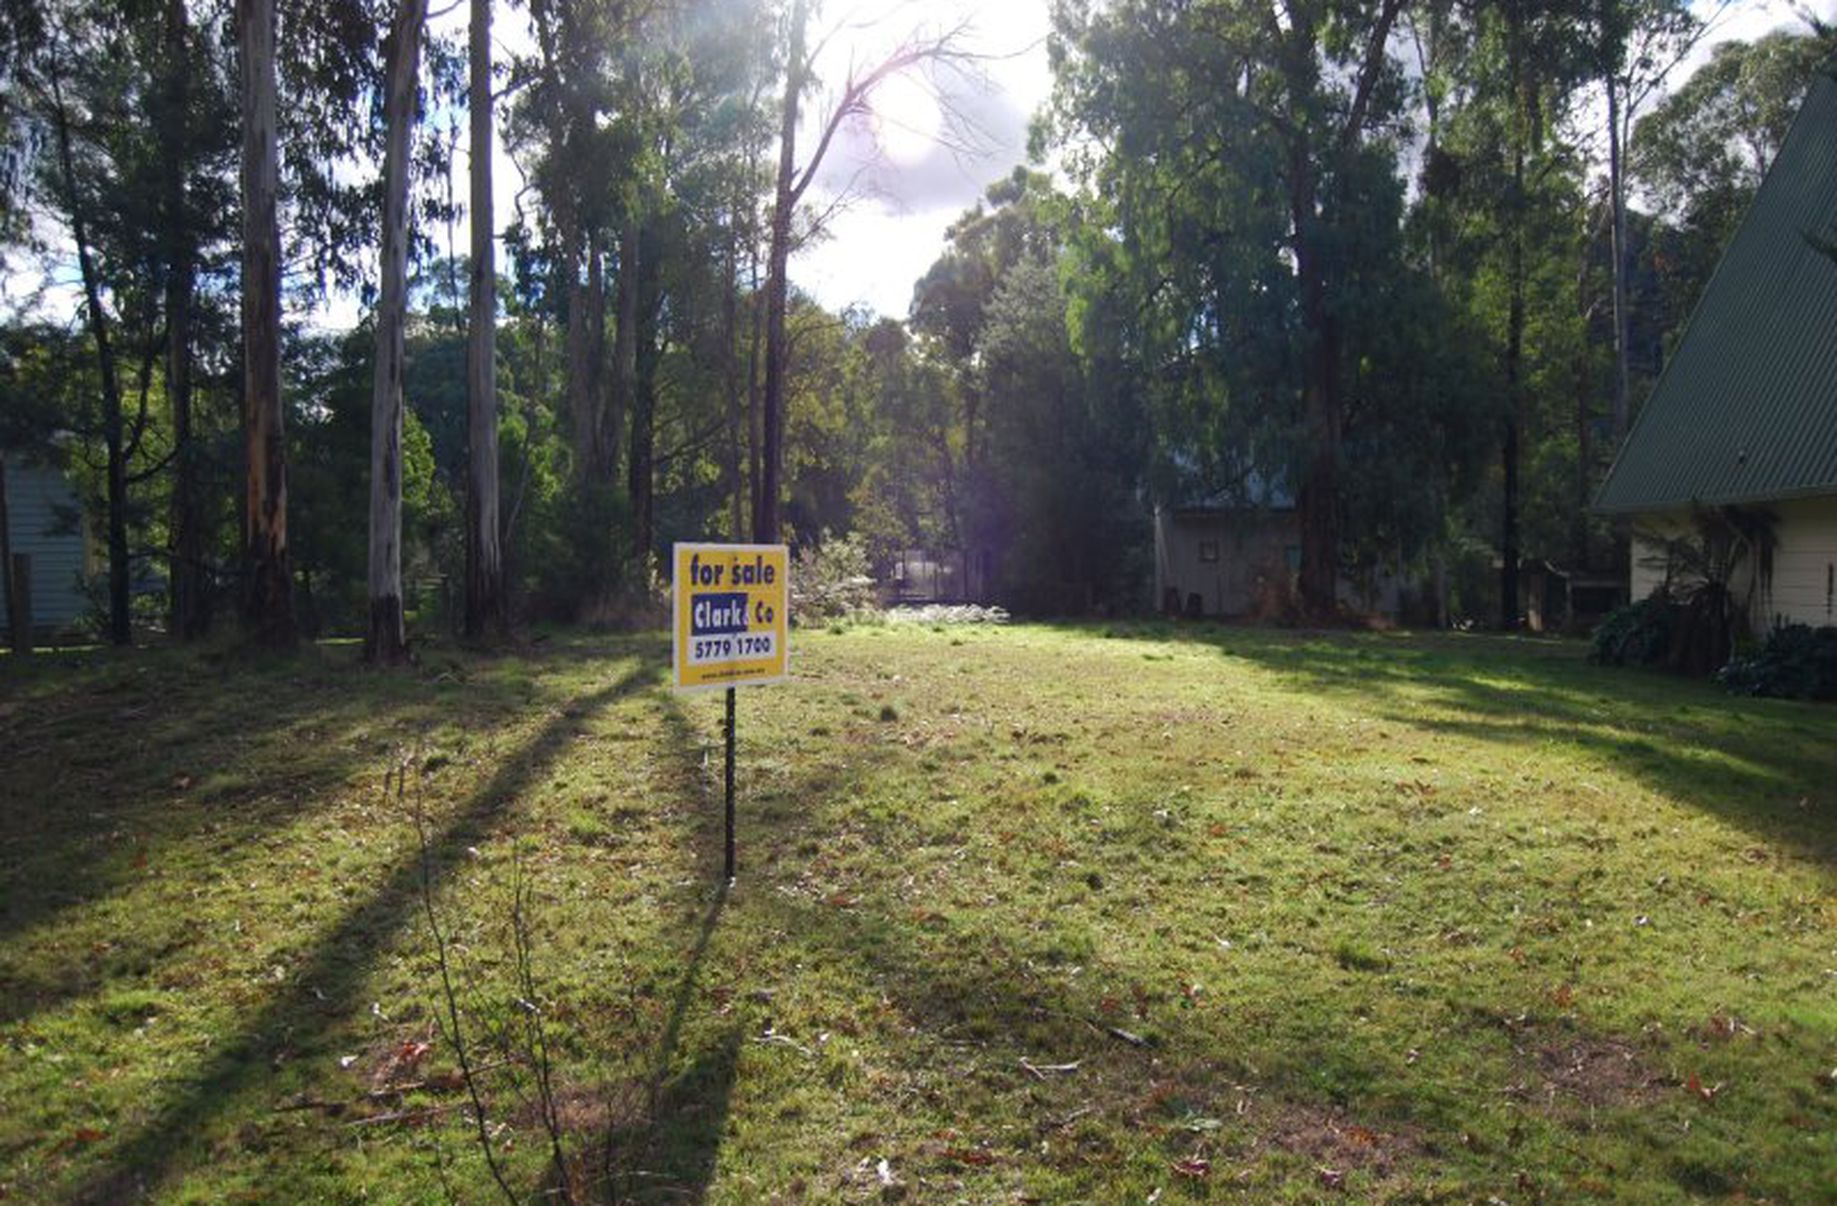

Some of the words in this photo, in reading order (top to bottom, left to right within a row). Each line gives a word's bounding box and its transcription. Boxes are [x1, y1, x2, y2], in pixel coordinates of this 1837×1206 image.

[690, 553, 724, 586] for
[731, 555, 775, 585] sale
[694, 601, 742, 628] Clark
[755, 600, 774, 623] Co
[695, 639, 731, 659] 5779
[737, 637, 771, 654] 1700
